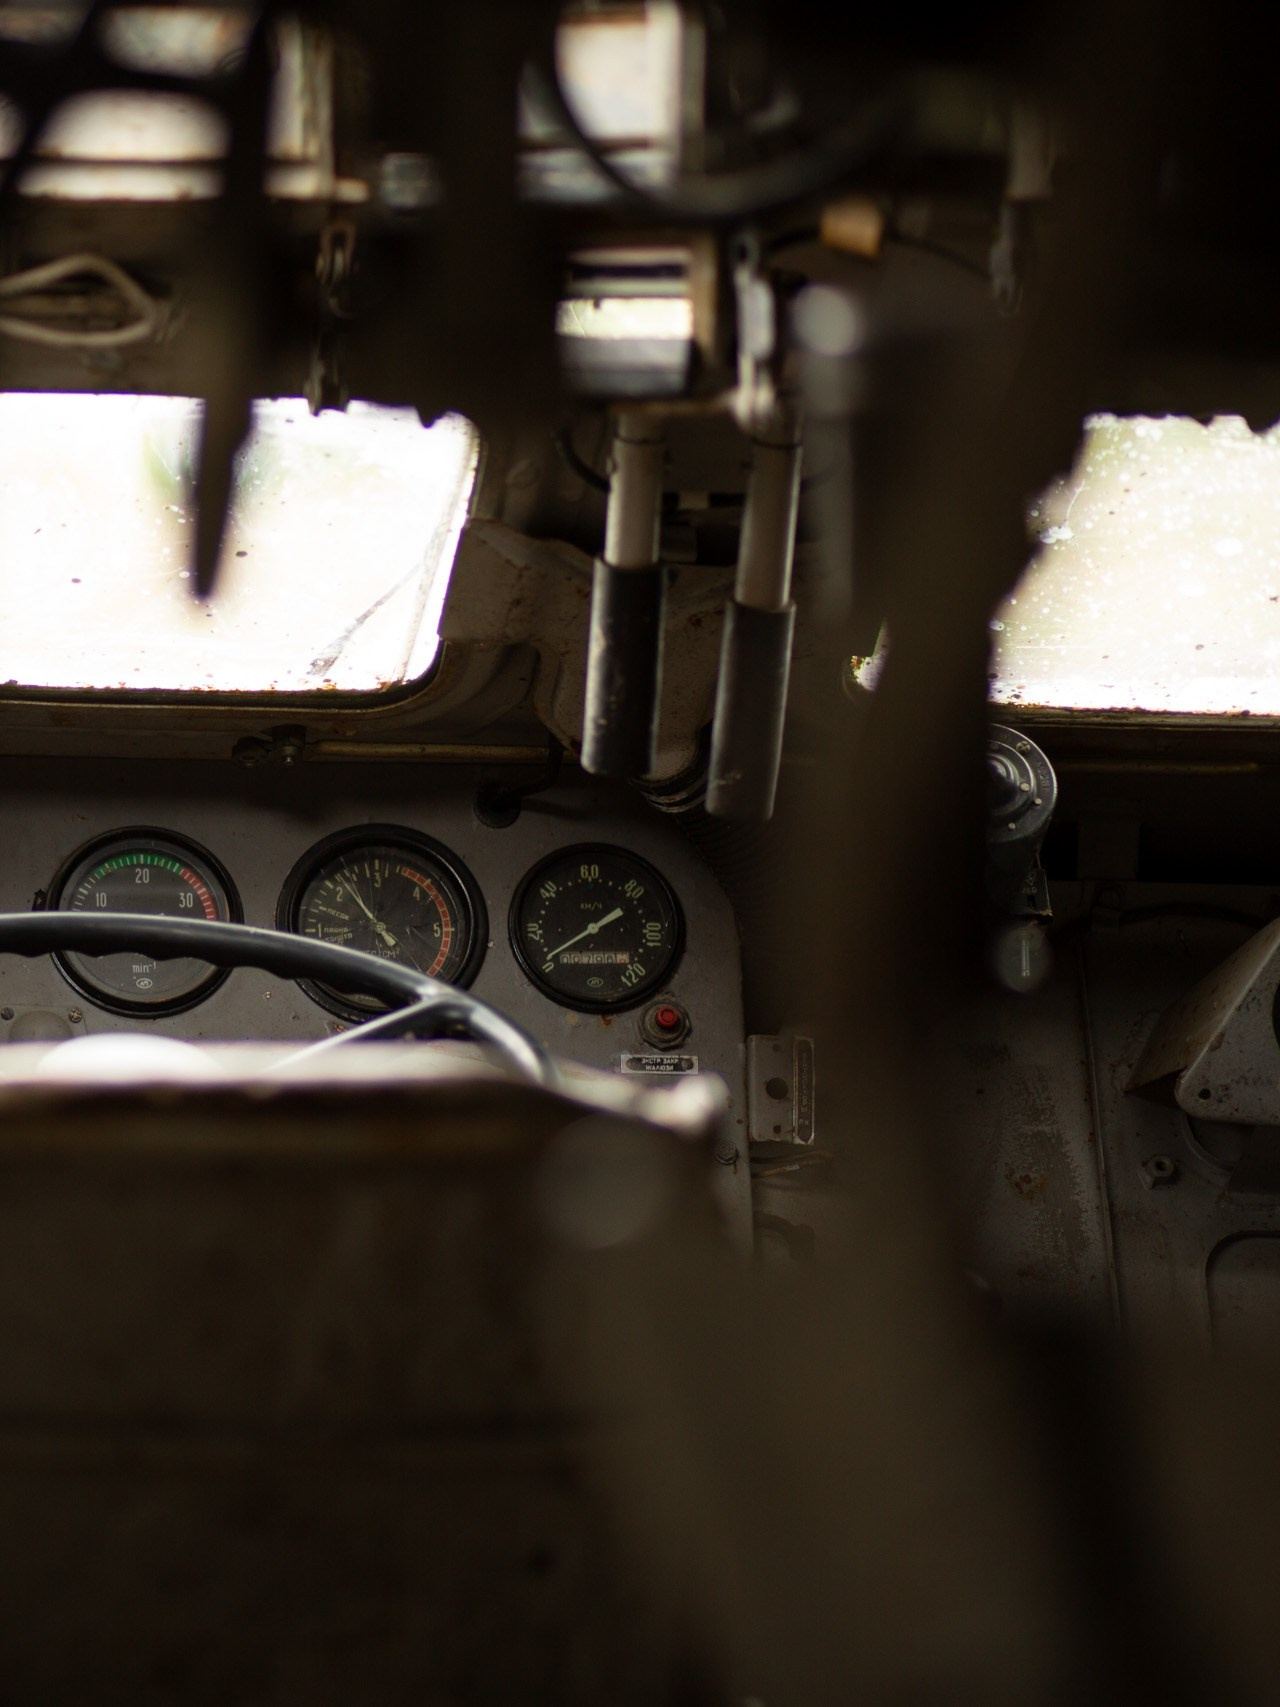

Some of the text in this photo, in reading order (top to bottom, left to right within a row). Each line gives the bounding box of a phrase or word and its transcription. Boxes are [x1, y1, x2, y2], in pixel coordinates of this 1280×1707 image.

[135, 868, 150, 884] 20
[580, 864, 599, 879] 60
[373, 872, 382, 888] 3
[335, 887, 343, 902] 2
[412, 886, 421, 901] 4
[539, 881, 557, 900] 40
[624, 879, 645, 899] 80
[95, 892, 108, 908] 10
[178, 892, 194, 908] 30
[317, 923, 322, 938] 1
[433, 922, 441, 938] 5
[526, 922, 540, 942] 20
[646, 922, 662, 947] 100
[542, 961, 555, 973] 0
[621, 962, 646, 987] 120
